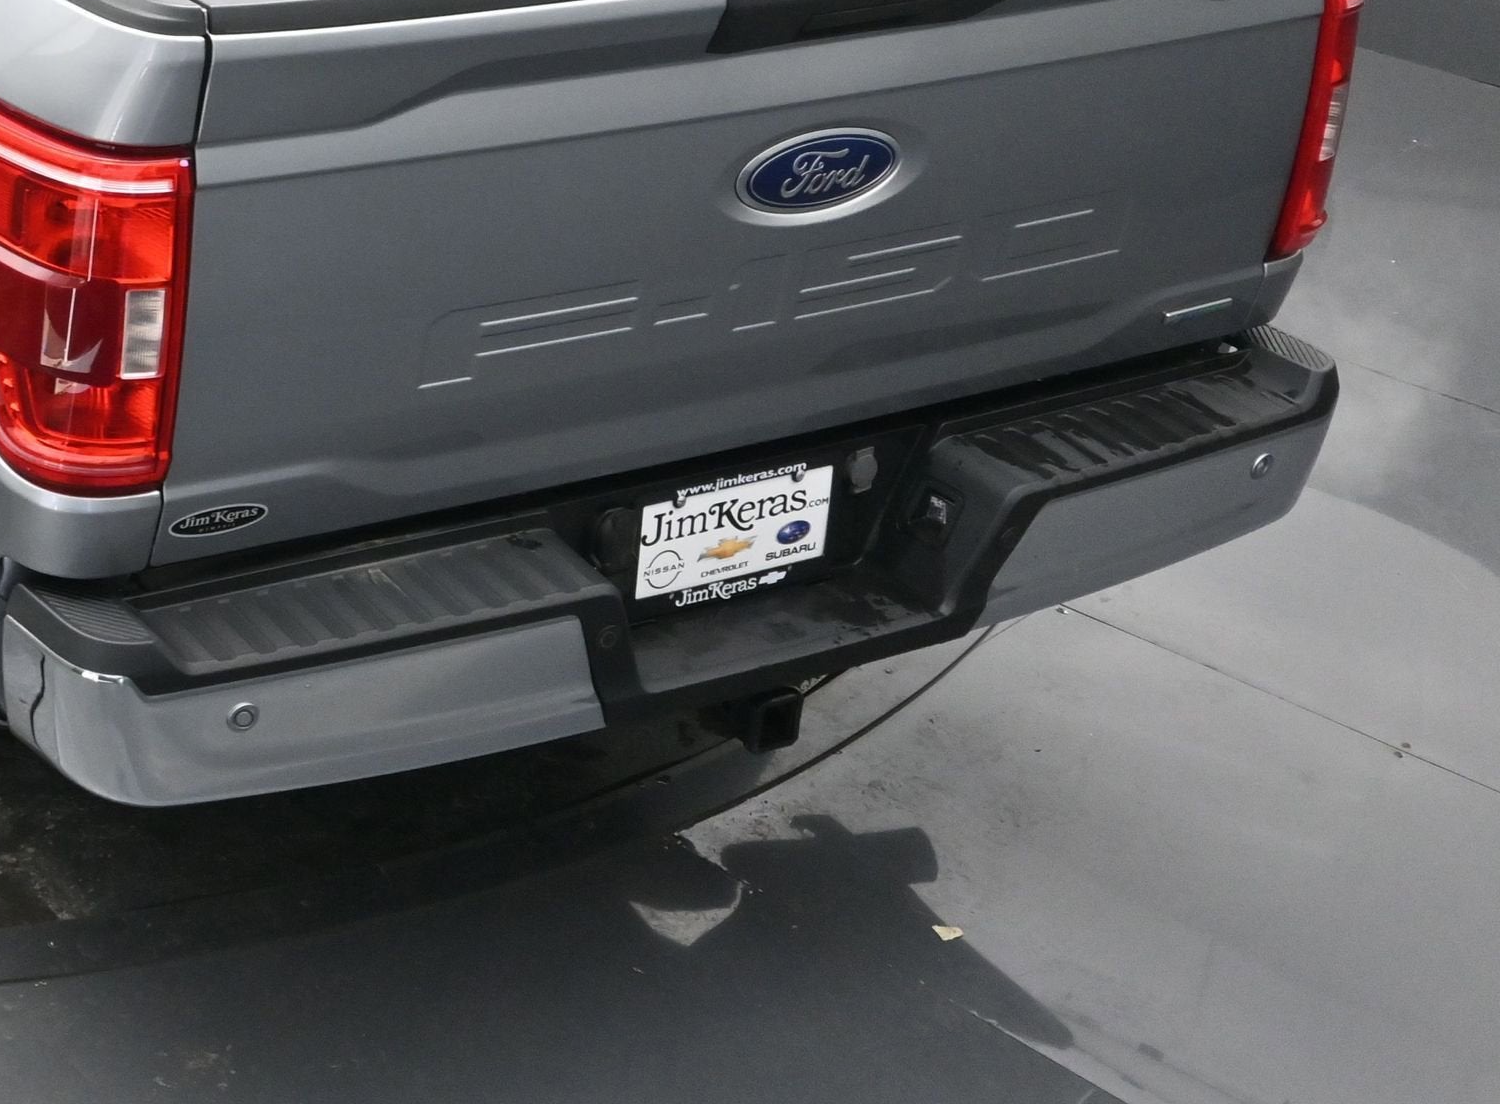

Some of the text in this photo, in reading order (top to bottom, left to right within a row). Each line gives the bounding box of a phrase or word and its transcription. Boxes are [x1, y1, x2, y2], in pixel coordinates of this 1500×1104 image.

[780, 147, 870, 199] Ford
[677, 462, 807, 498] www.jimkeras.com
[765, 542, 816, 561] SUBARU
[643, 561, 685, 578] NISSAN
[701, 561, 749, 578] CHEVROLET
